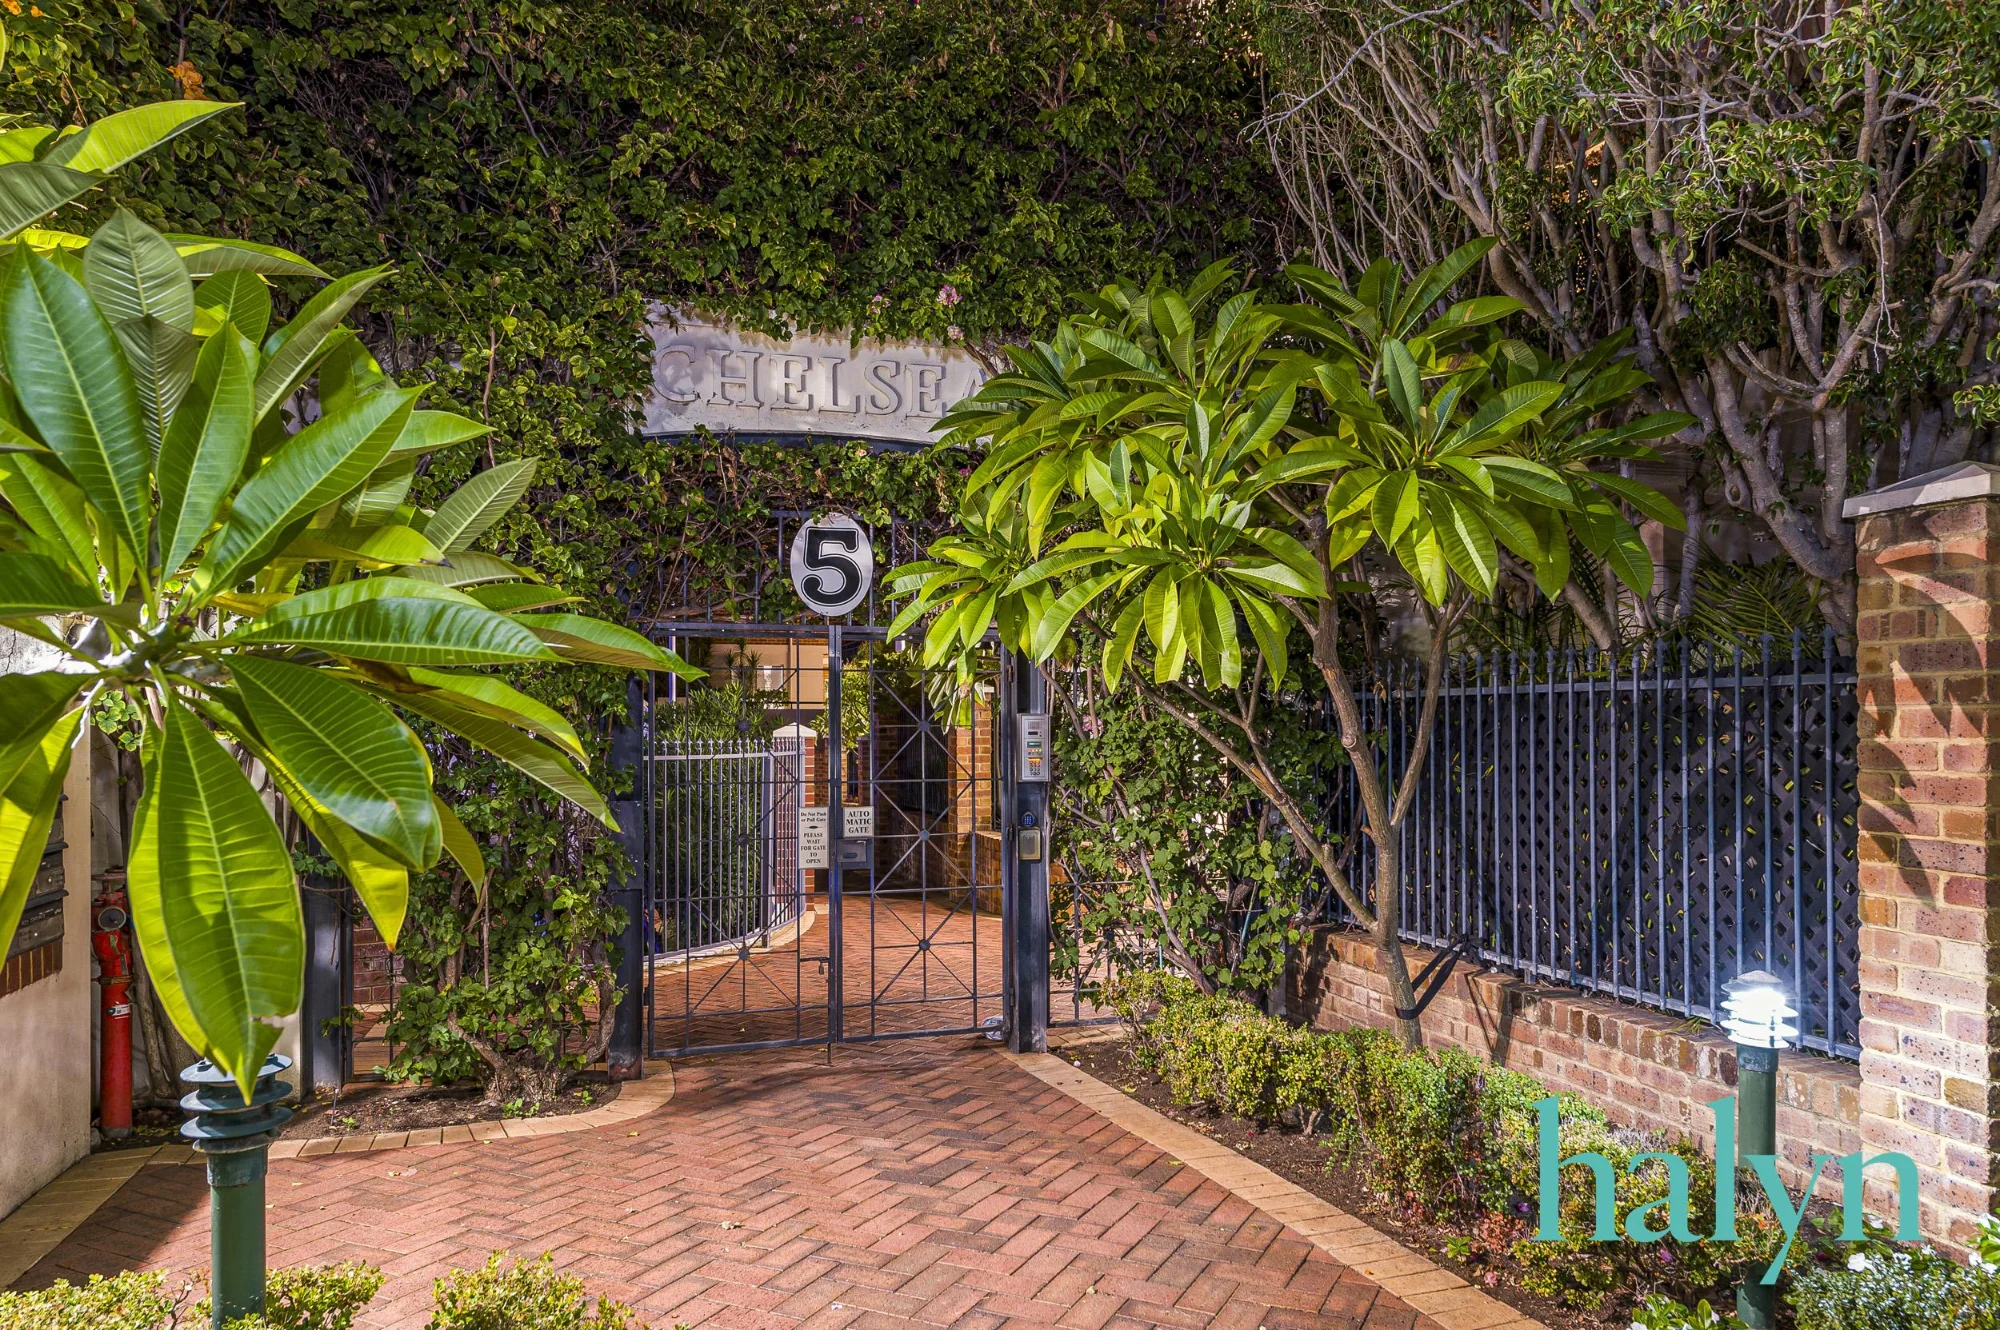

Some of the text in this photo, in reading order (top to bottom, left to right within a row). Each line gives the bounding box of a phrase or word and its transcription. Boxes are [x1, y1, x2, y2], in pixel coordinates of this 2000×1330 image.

[801, 526, 863, 607] 5
[848, 810, 870, 818] AUTO
[845, 818, 872, 826] MATIC
[848, 826, 870, 834] GATE
